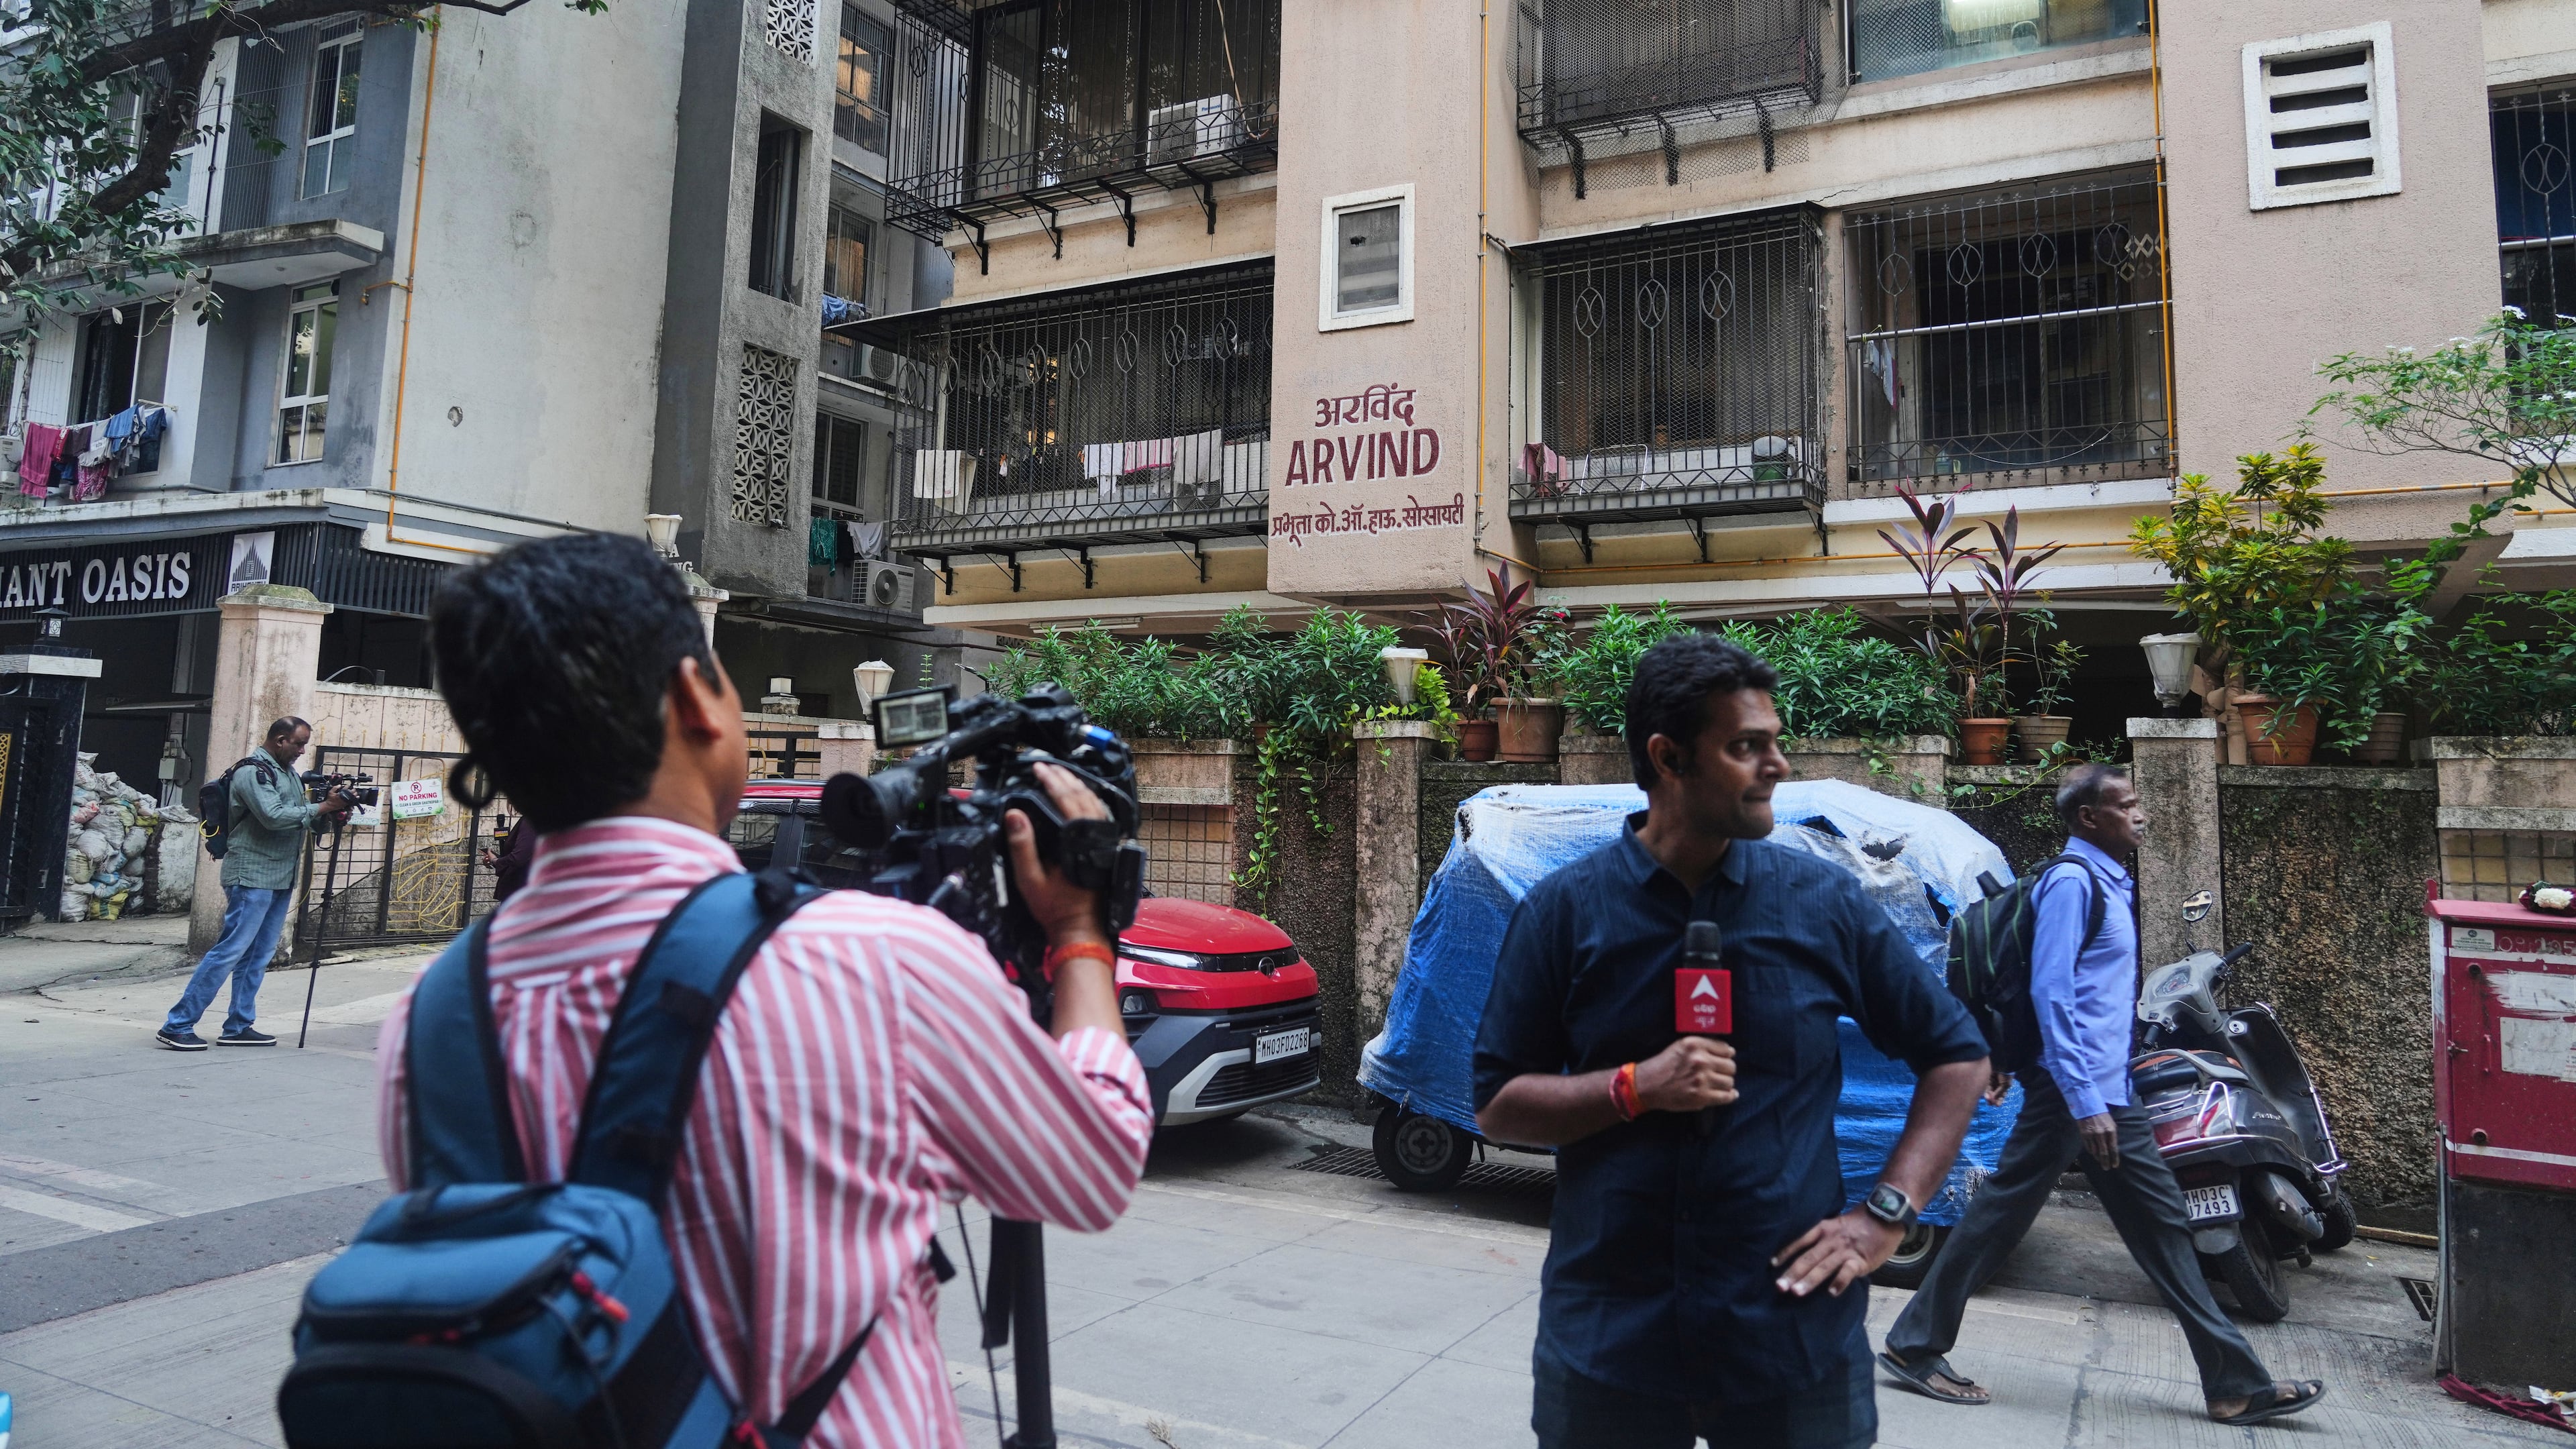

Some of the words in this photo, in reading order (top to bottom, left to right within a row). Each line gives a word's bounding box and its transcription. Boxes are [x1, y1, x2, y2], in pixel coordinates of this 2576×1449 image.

[1315, 382, 1417, 427] अरविंद
[1285, 428, 1440, 486] ARVIND
[1271, 512, 1312, 549] प्रभूता
[0, 559, 72, 608] ANT
[83, 551, 191, 604] OASIS
[409, 792, 437, 800] PARKING
[1262, 1032, 1308, 1057] MH03FD2268
